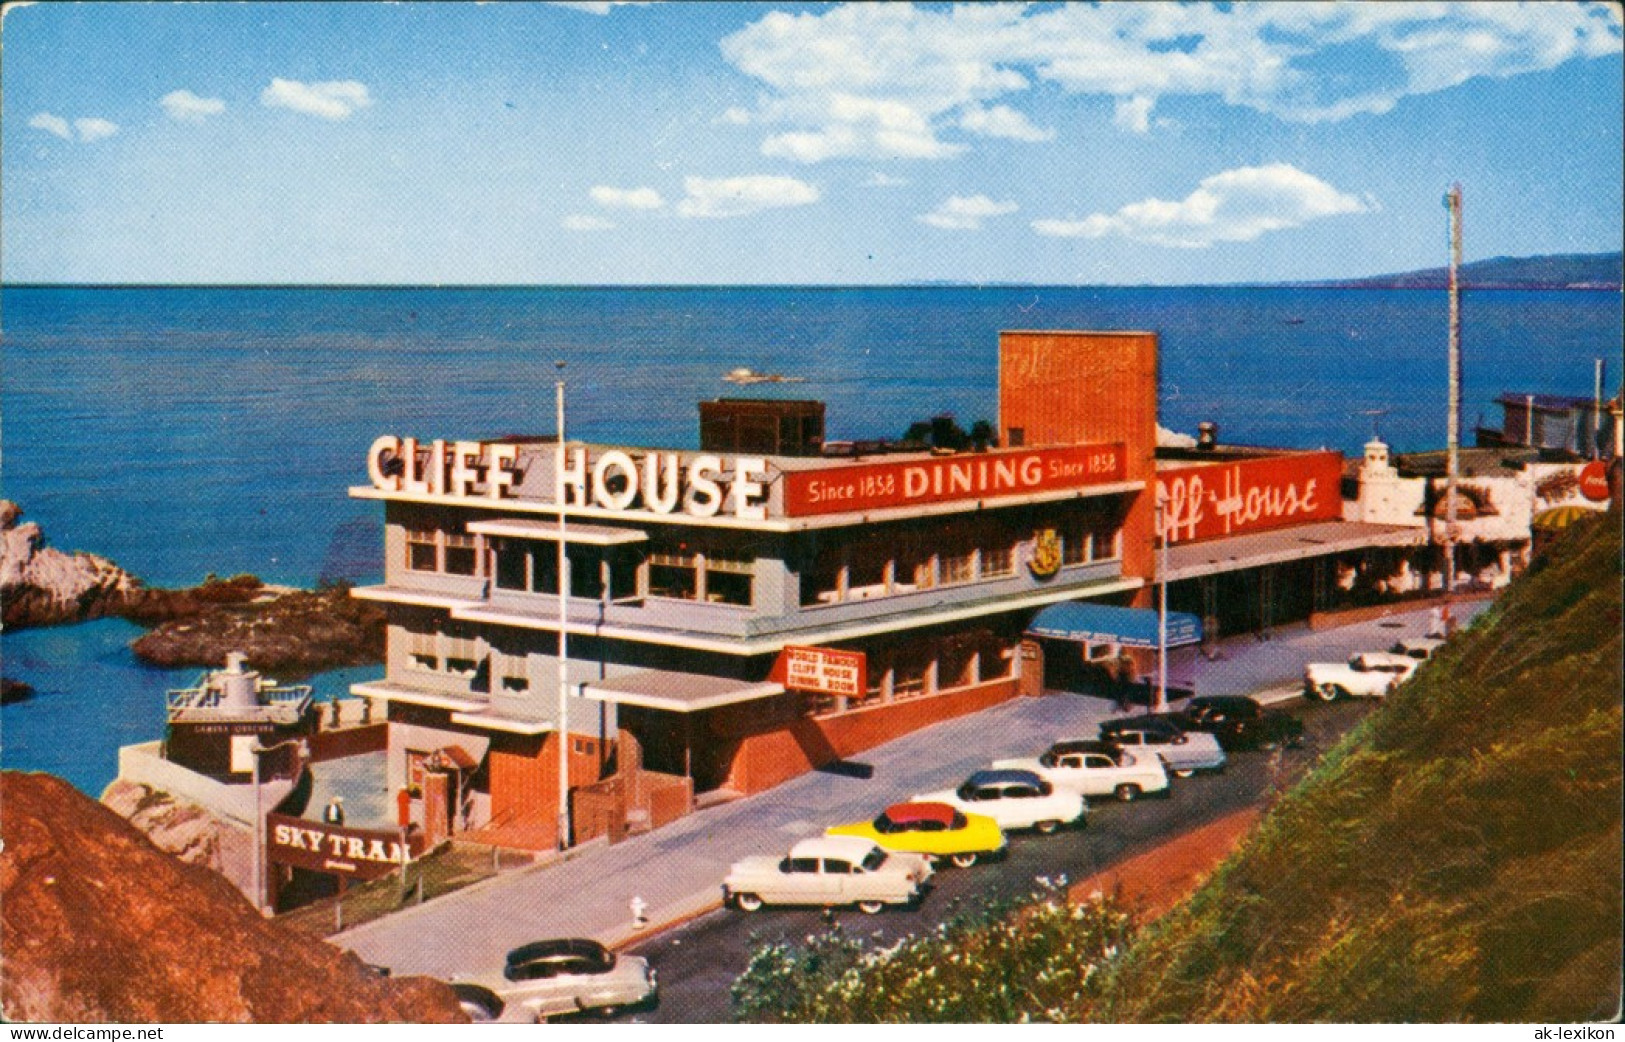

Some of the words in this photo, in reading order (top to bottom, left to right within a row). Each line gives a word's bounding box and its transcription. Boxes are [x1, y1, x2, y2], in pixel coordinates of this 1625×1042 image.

[367, 434, 518, 501] CLIFF
[555, 447, 769, 521] HOUSE
[808, 480, 855, 503] Since
[859, 473, 896, 497] 1858
[904, 456, 1043, 498] DINING
[1048, 460, 1084, 479] Since
[1088, 452, 1117, 473] 1858
[1209, 465, 1319, 534] House
[274, 823, 325, 853] SKY
